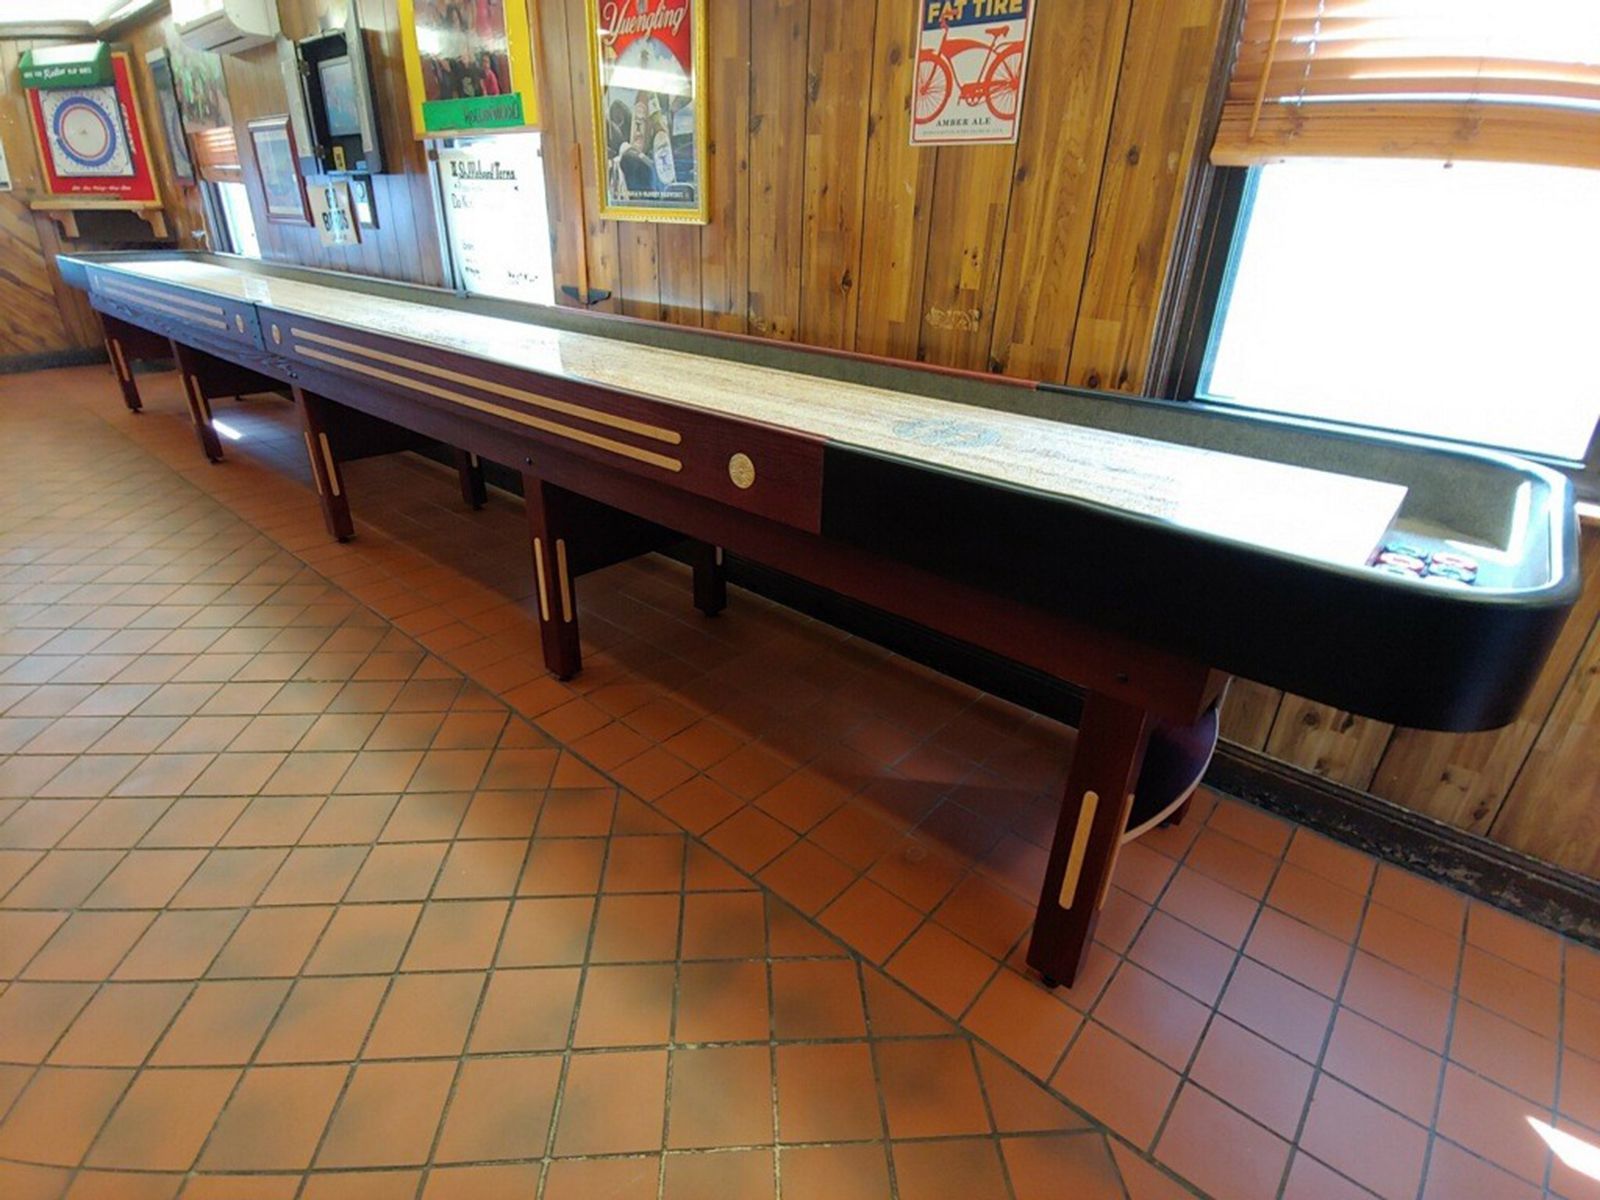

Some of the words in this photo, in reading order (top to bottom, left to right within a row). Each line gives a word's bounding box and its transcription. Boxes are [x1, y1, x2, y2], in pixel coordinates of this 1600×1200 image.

[603, 0, 688, 45] Yuengling
[927, 0, 967, 23] FAT
[972, 0, 1023, 18] TIRE
[936, 118, 969, 127] AMBER
[972, 117, 992, 126] ALE
